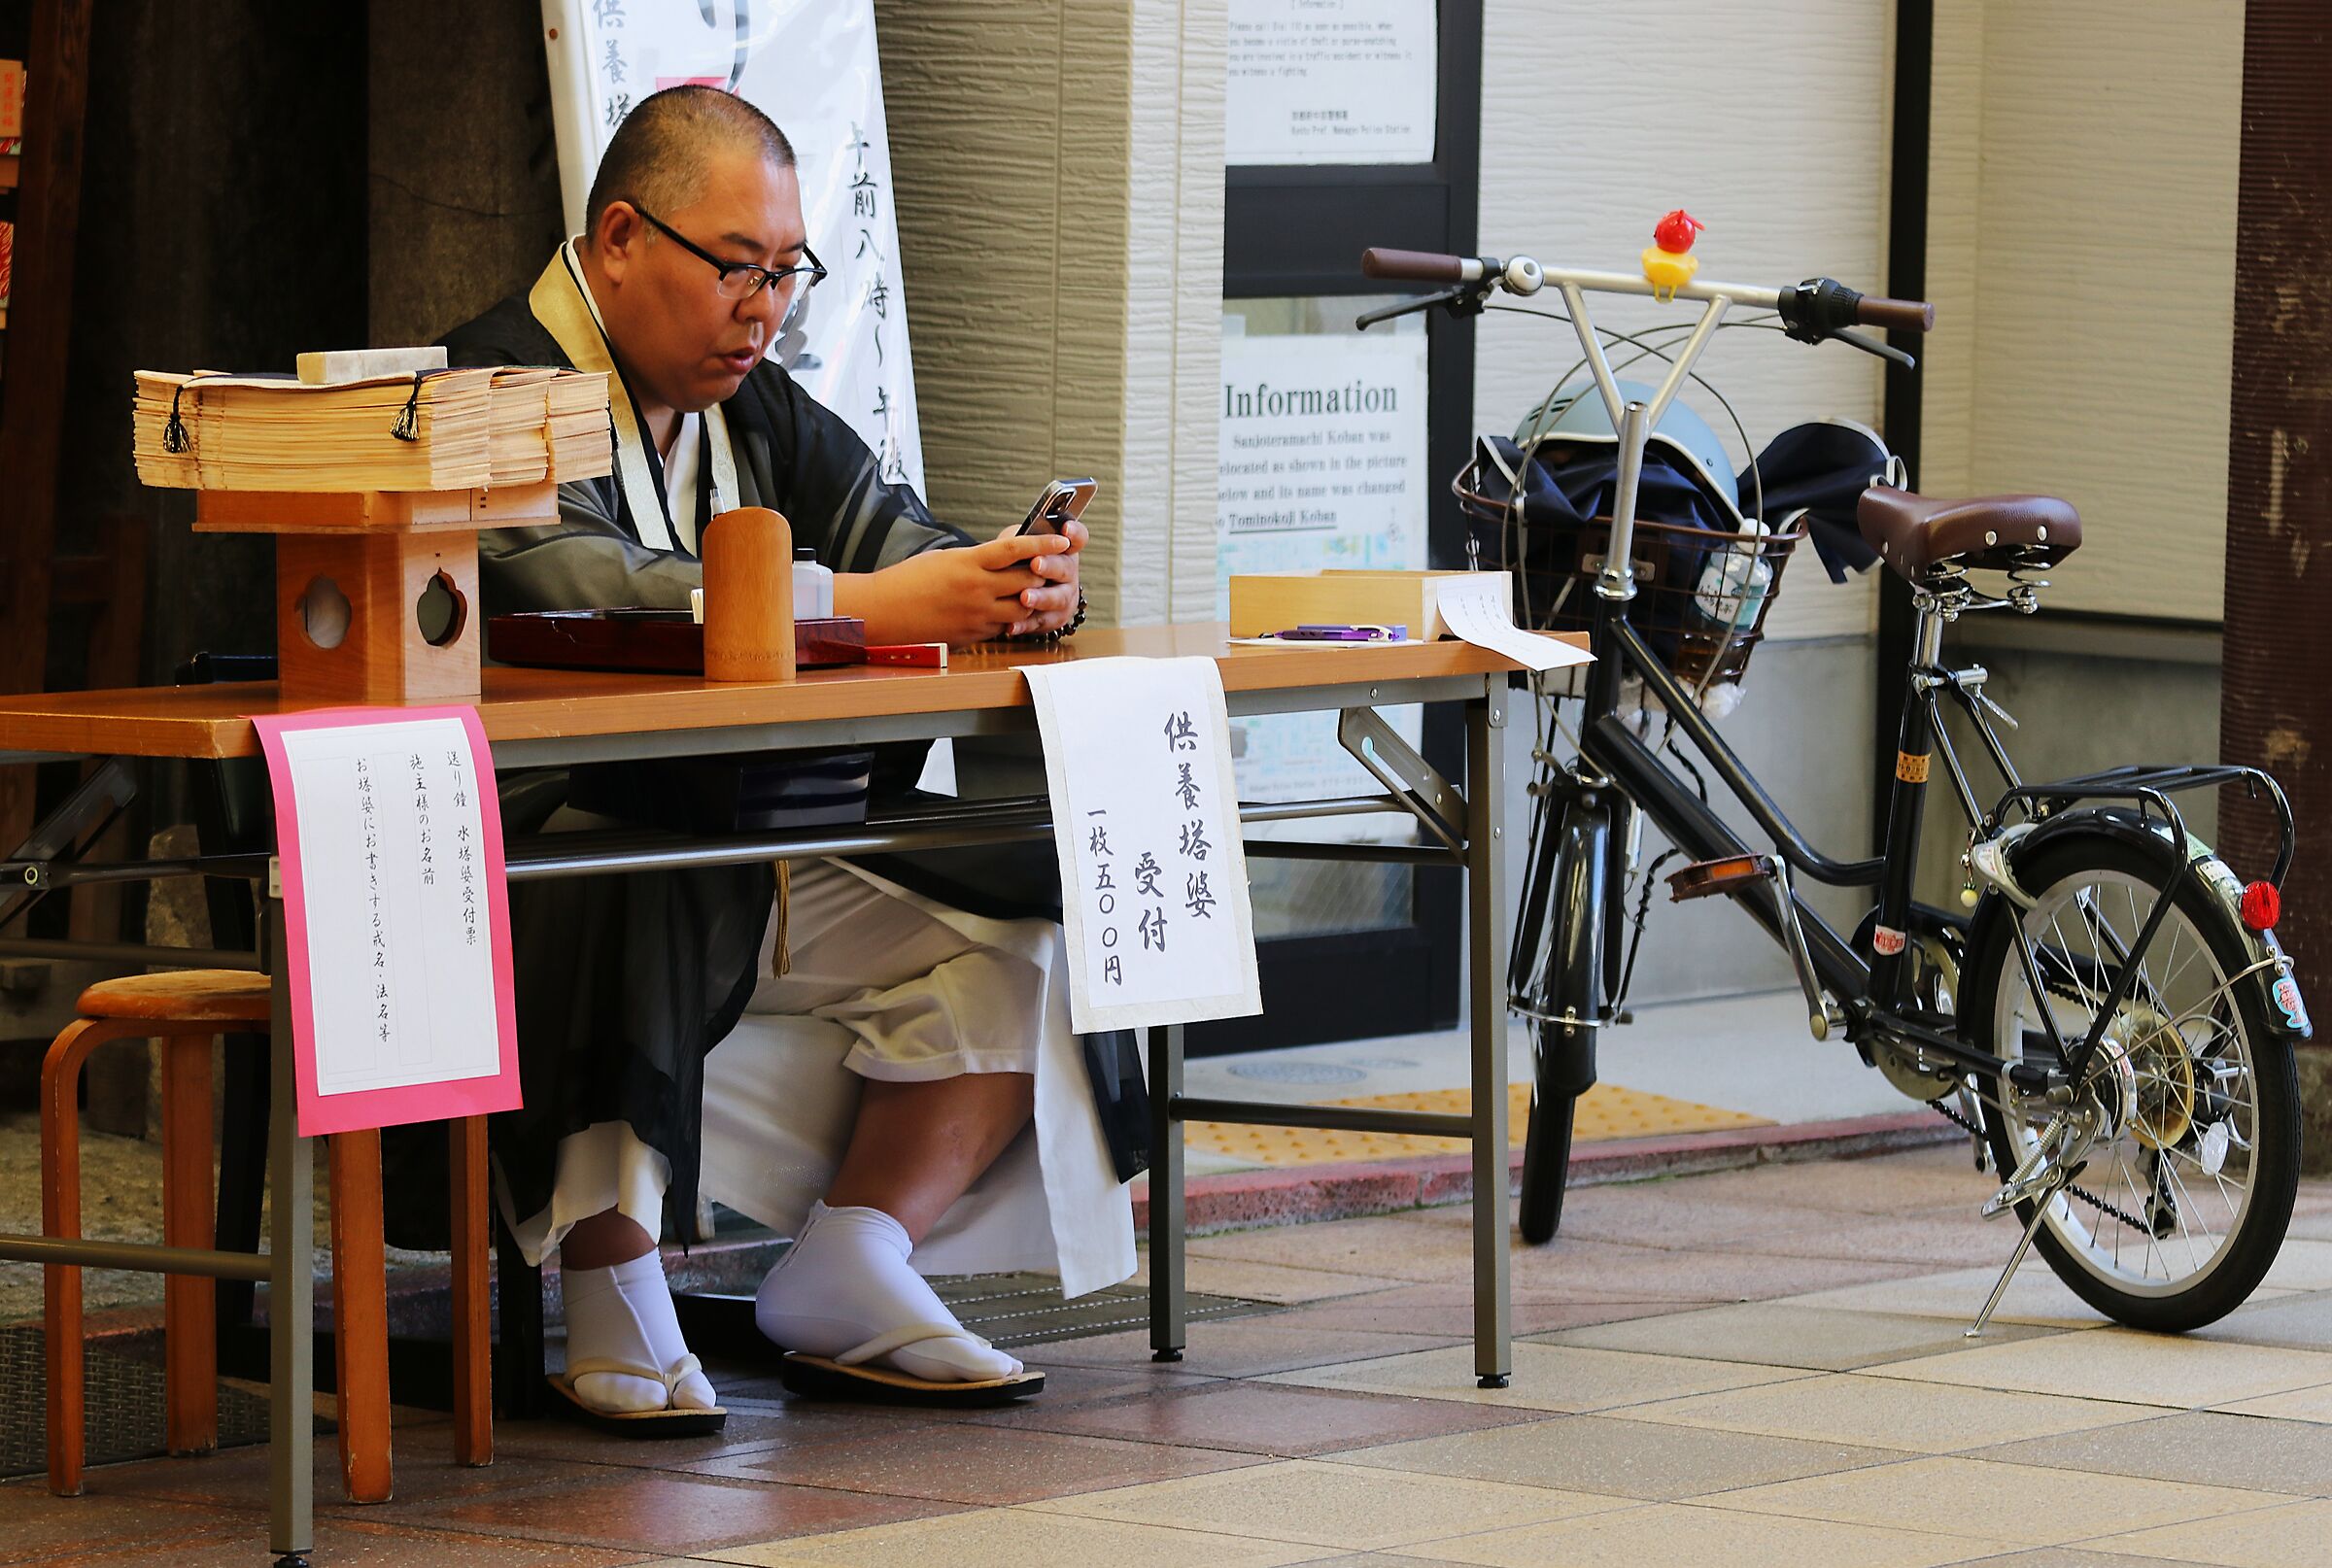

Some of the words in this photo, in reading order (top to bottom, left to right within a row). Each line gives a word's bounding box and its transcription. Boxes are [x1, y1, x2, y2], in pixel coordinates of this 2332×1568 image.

[1223, 380, 1398, 420] Information
[1232, 431, 1322, 449] Sanjoteramachi
[1327, 430, 1364, 445] Koban
[1368, 432, 1391, 444] was
[1219, 460, 1268, 475] elocated
[1273, 462, 1284, 473] as
[1288, 459, 1326, 472] shown
[1330, 457, 1340, 470] in
[1344, 456, 1362, 470] the
[1366, 455, 1407, 471] picture
[1253, 486, 1275, 499] and
[1280, 485, 1293, 498] its
[1297, 487, 1326, 498] name
[1331, 485, 1353, 496] was
[1356, 480, 1406, 496] changed
[1229, 510, 1294, 528] Tominokoji
[1299, 510, 1337, 526] Koban
[409, 754, 436, 886] 施主様のお名前
[1163, 710, 1217, 920] 供養塔婆
[446, 751, 468, 808] 送り鐘
[457, 824, 478, 945] 水塔婆受付票
[1134, 851, 1169, 953] 受付
